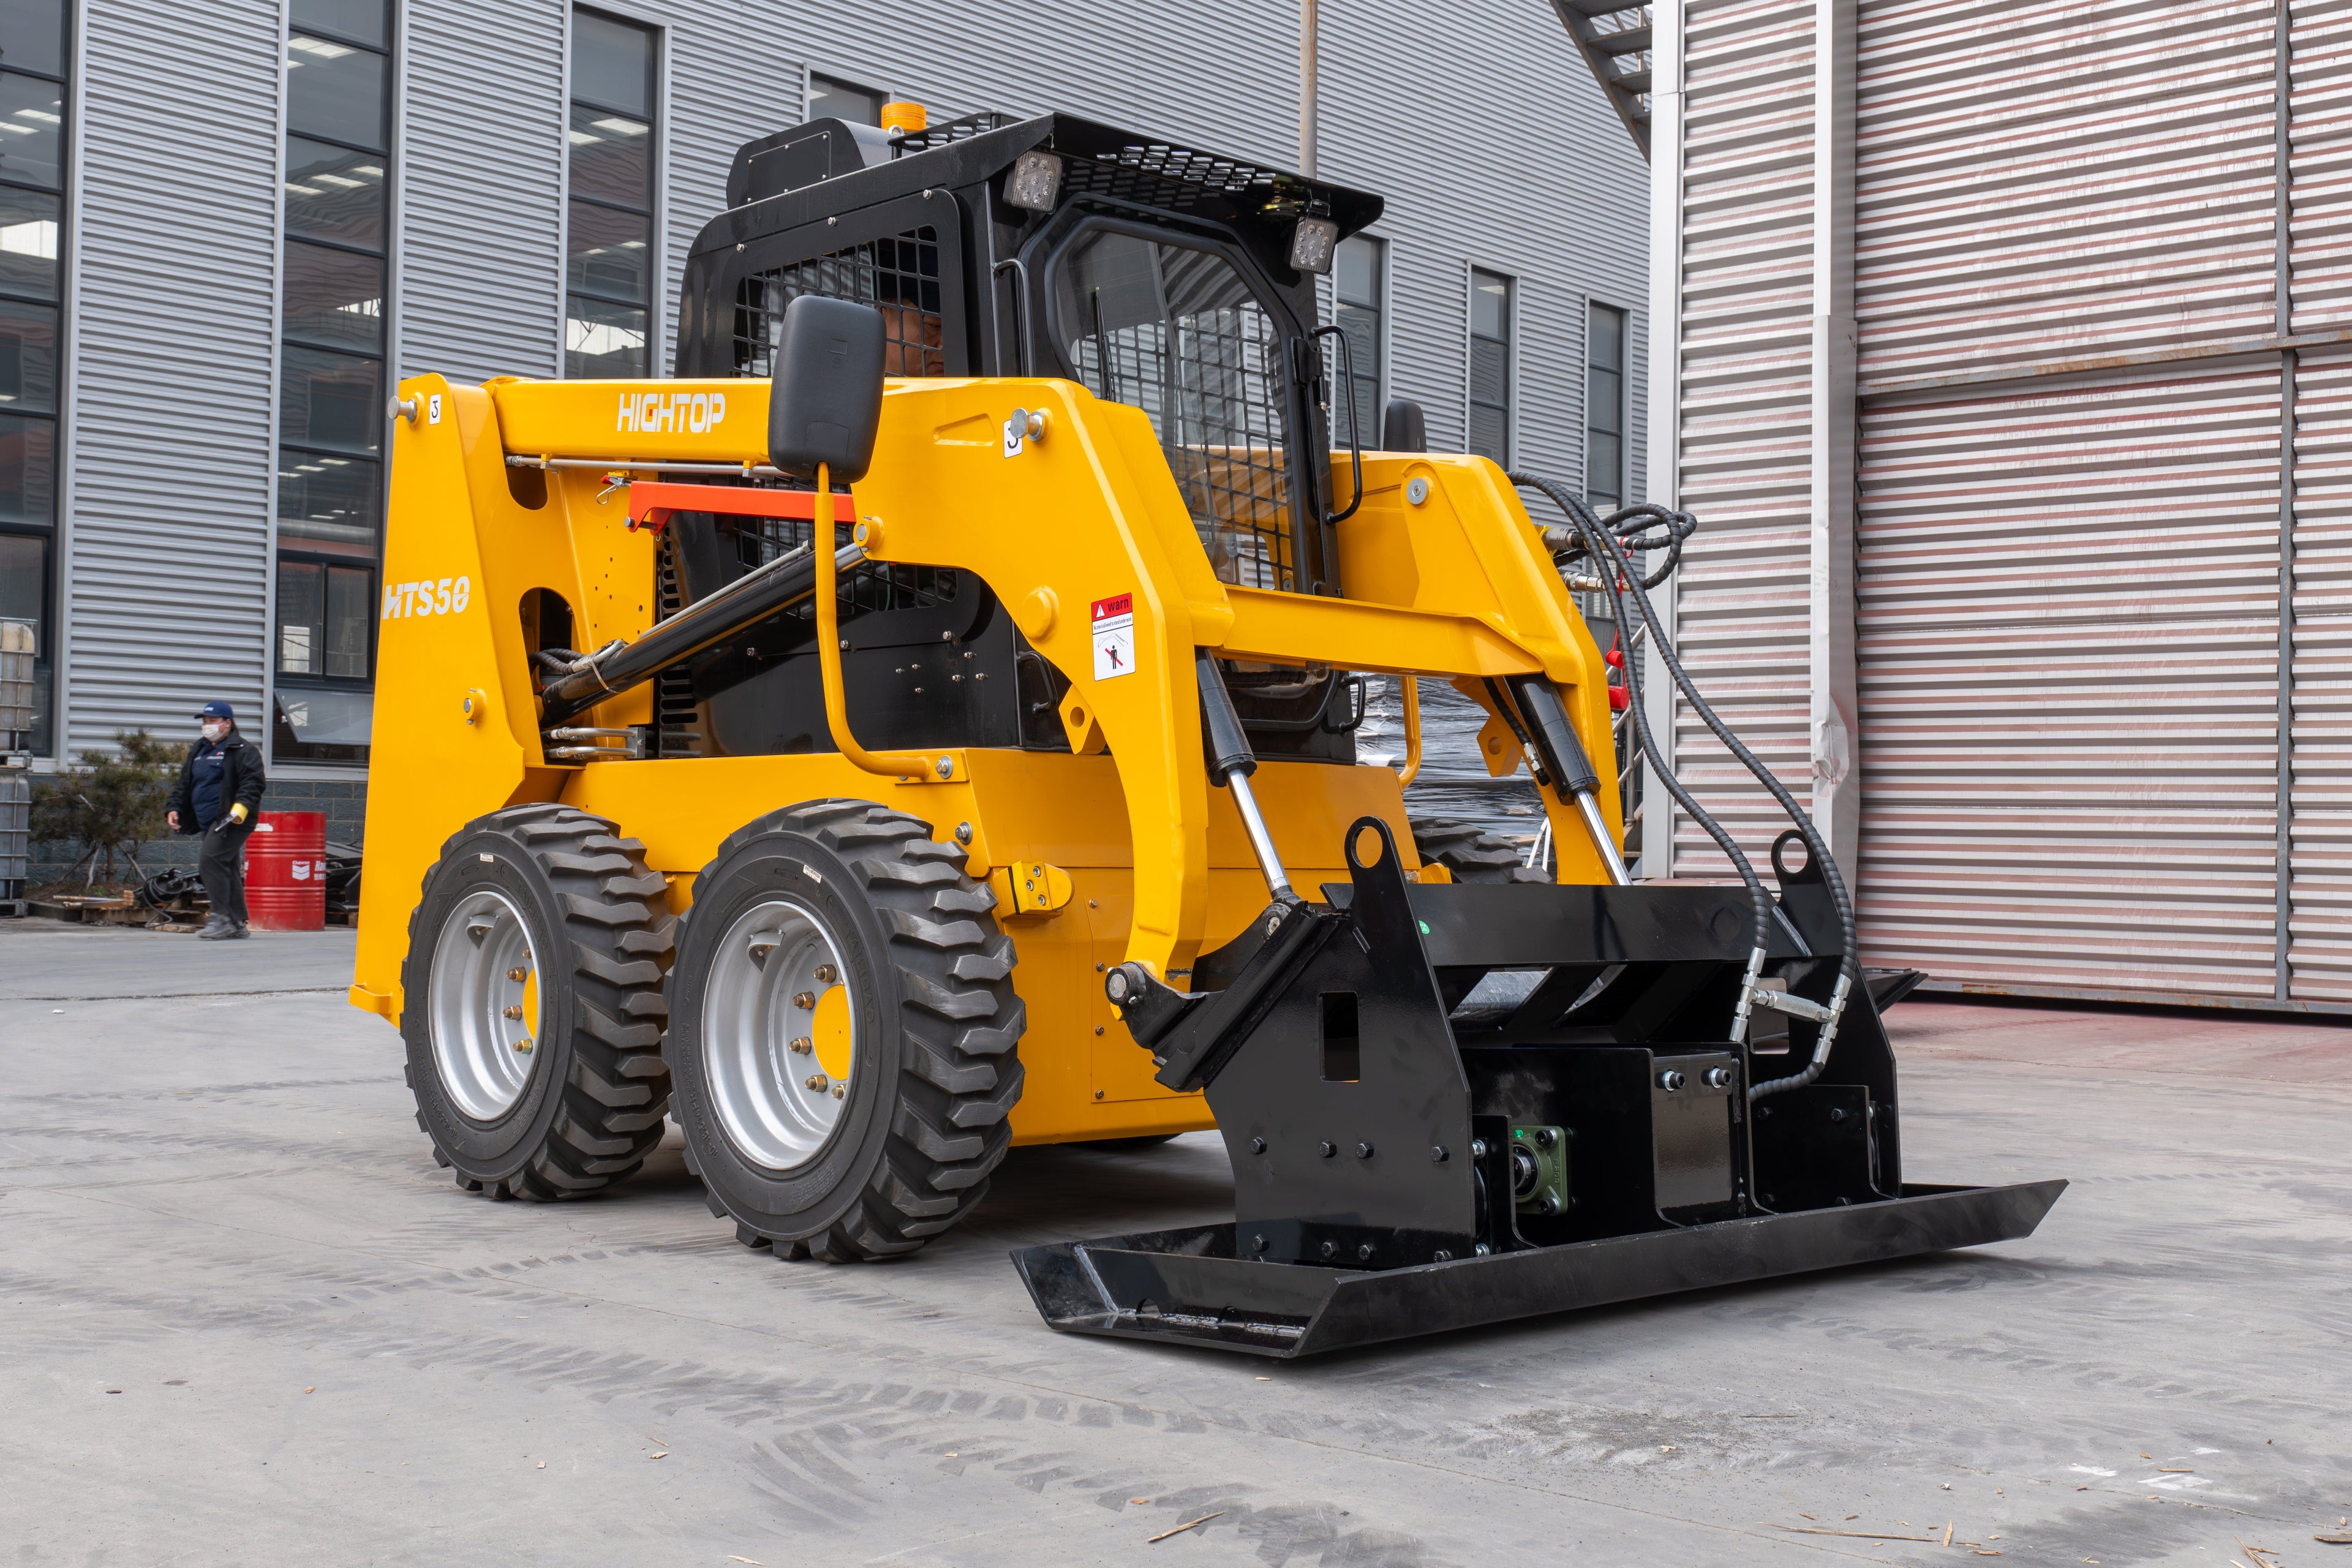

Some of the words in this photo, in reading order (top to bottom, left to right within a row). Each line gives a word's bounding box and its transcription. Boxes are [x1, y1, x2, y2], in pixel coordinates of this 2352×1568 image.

[617, 393, 726, 433] HIGHTOP
[382, 576, 470, 620] HTS50
[1108, 598, 1129, 612] warn
